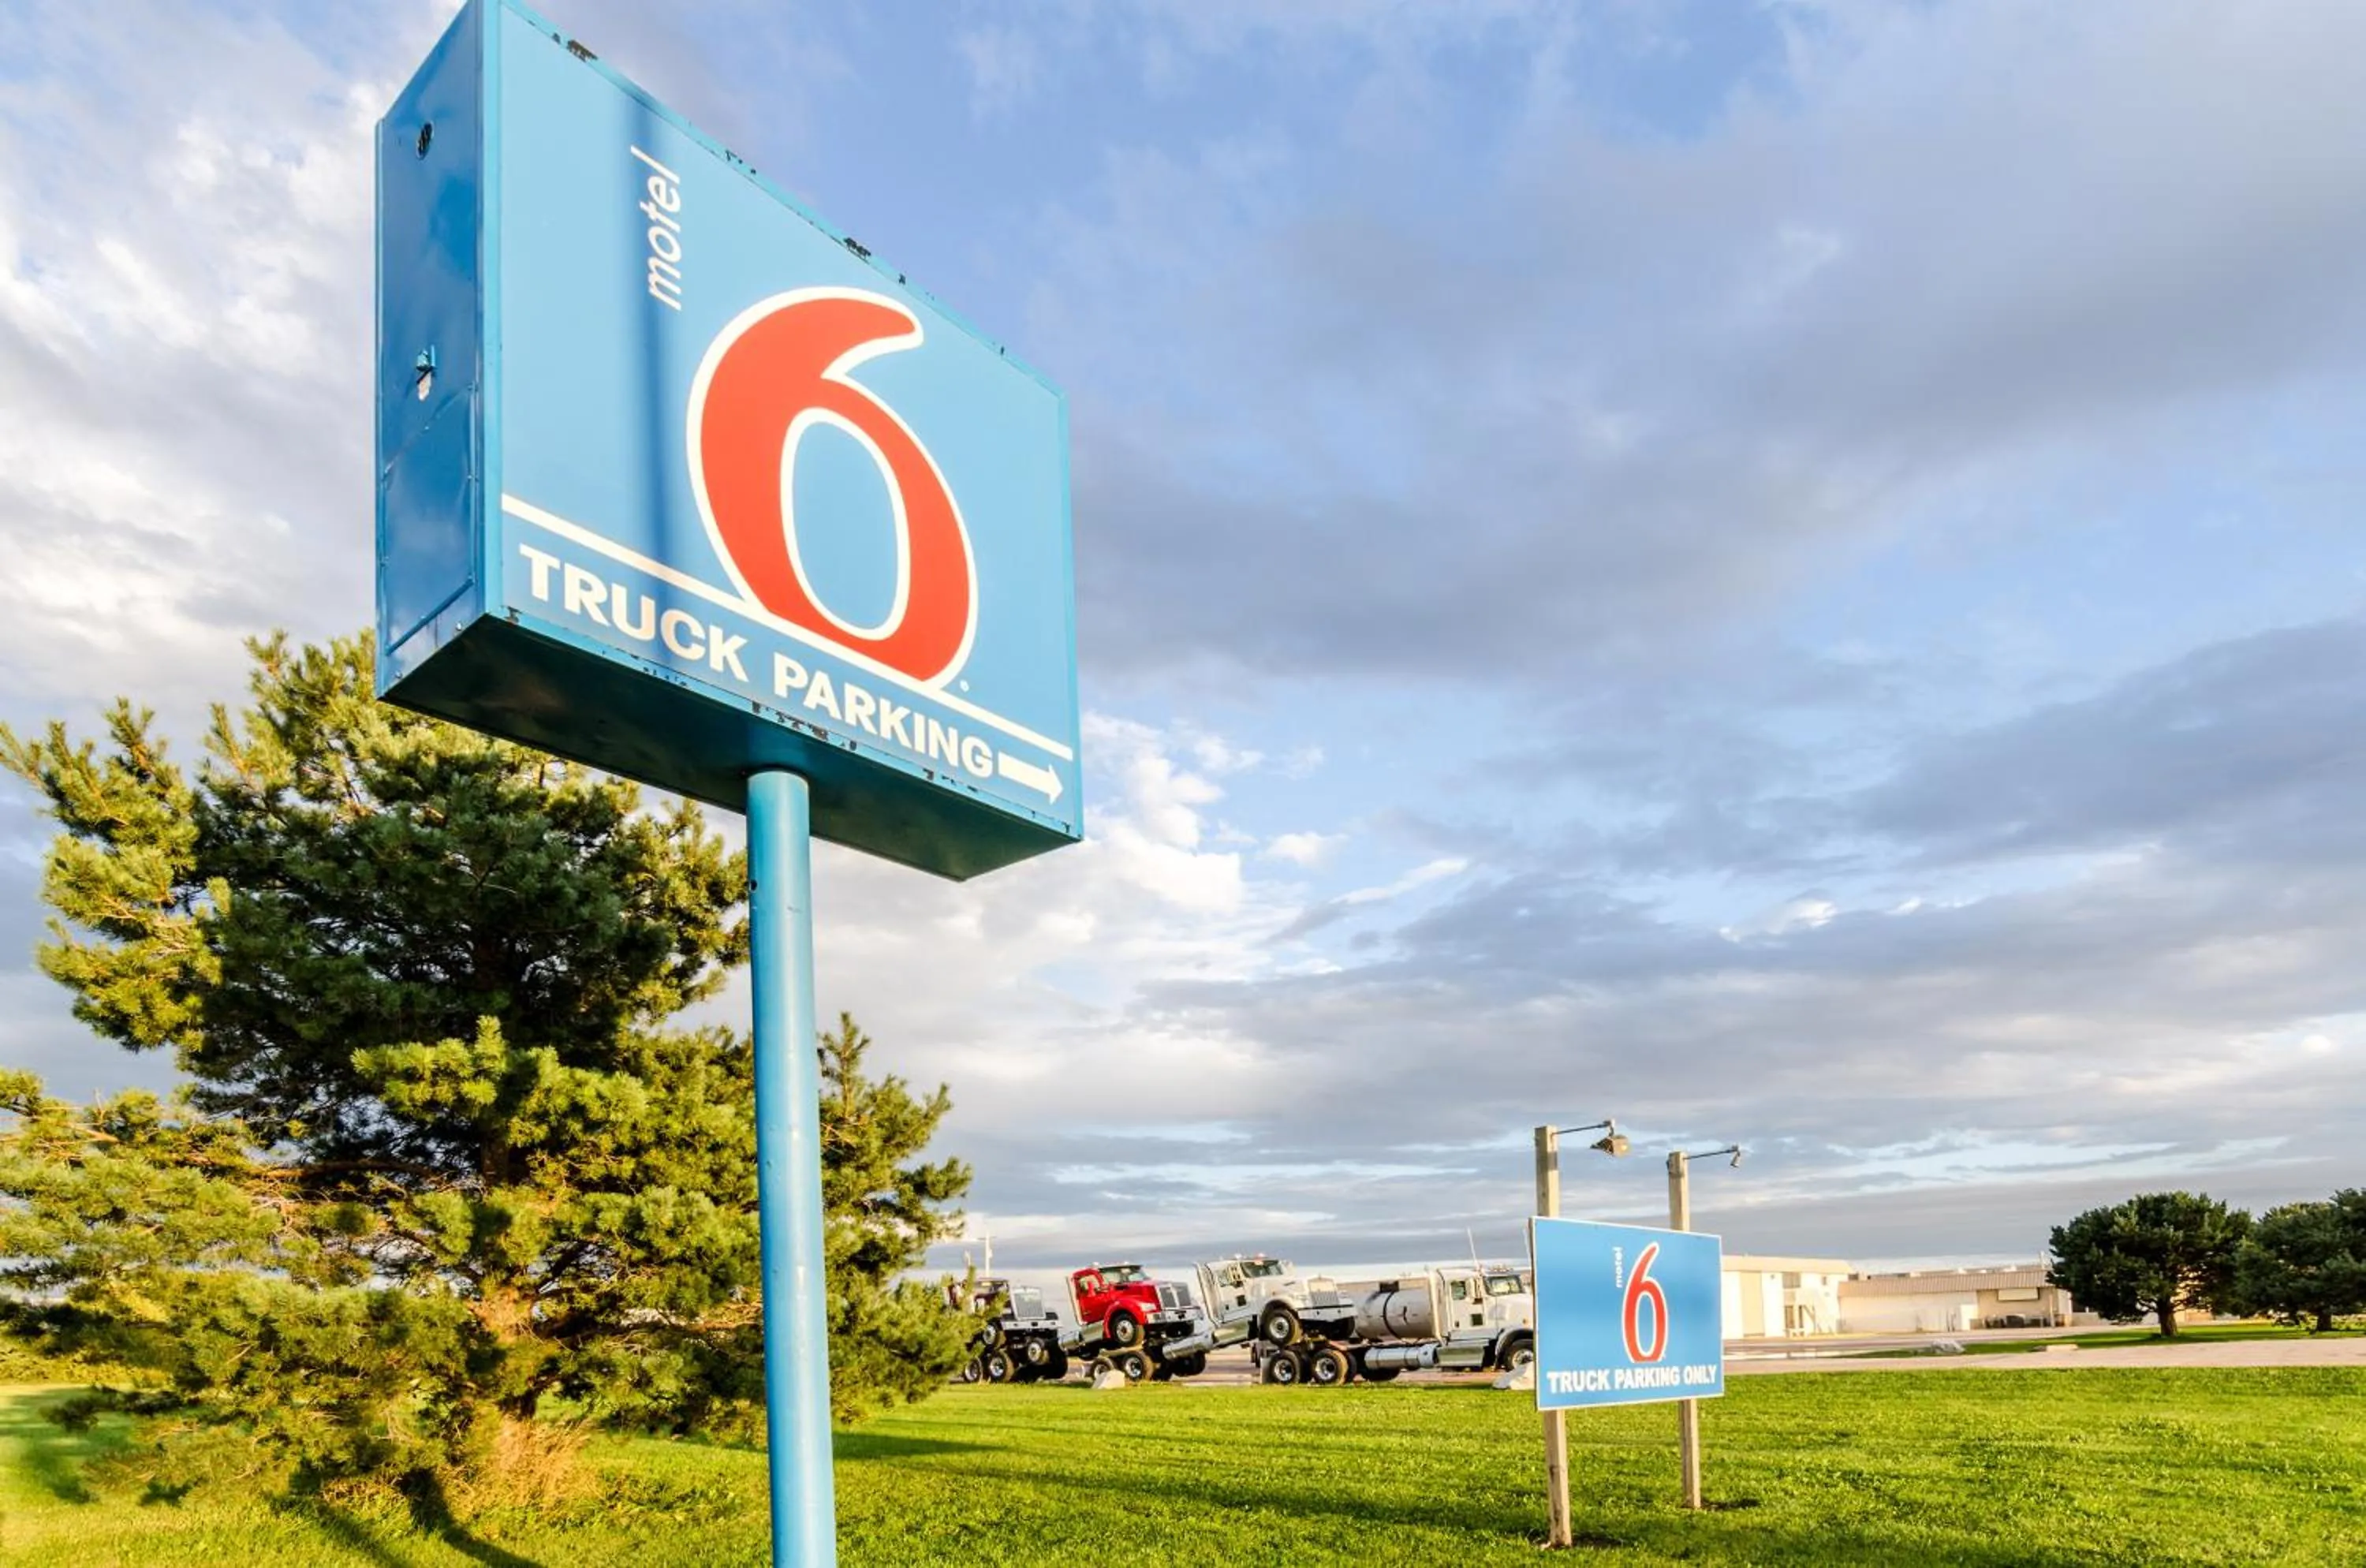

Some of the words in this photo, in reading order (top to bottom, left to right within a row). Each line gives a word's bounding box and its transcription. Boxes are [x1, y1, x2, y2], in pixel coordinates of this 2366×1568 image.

[629, 144, 683, 312] motel
[686, 286, 978, 691] 6
[519, 543, 748, 681] TRUCK
[774, 651, 995, 778] PARKING
[1613, 1246, 1623, 1288] motel
[1621, 1241, 1668, 1364] 6
[1547, 1368, 1610, 1394] TRUCK
[1615, 1365, 1680, 1389] PARKING
[1683, 1365, 1717, 1384] ONLY
